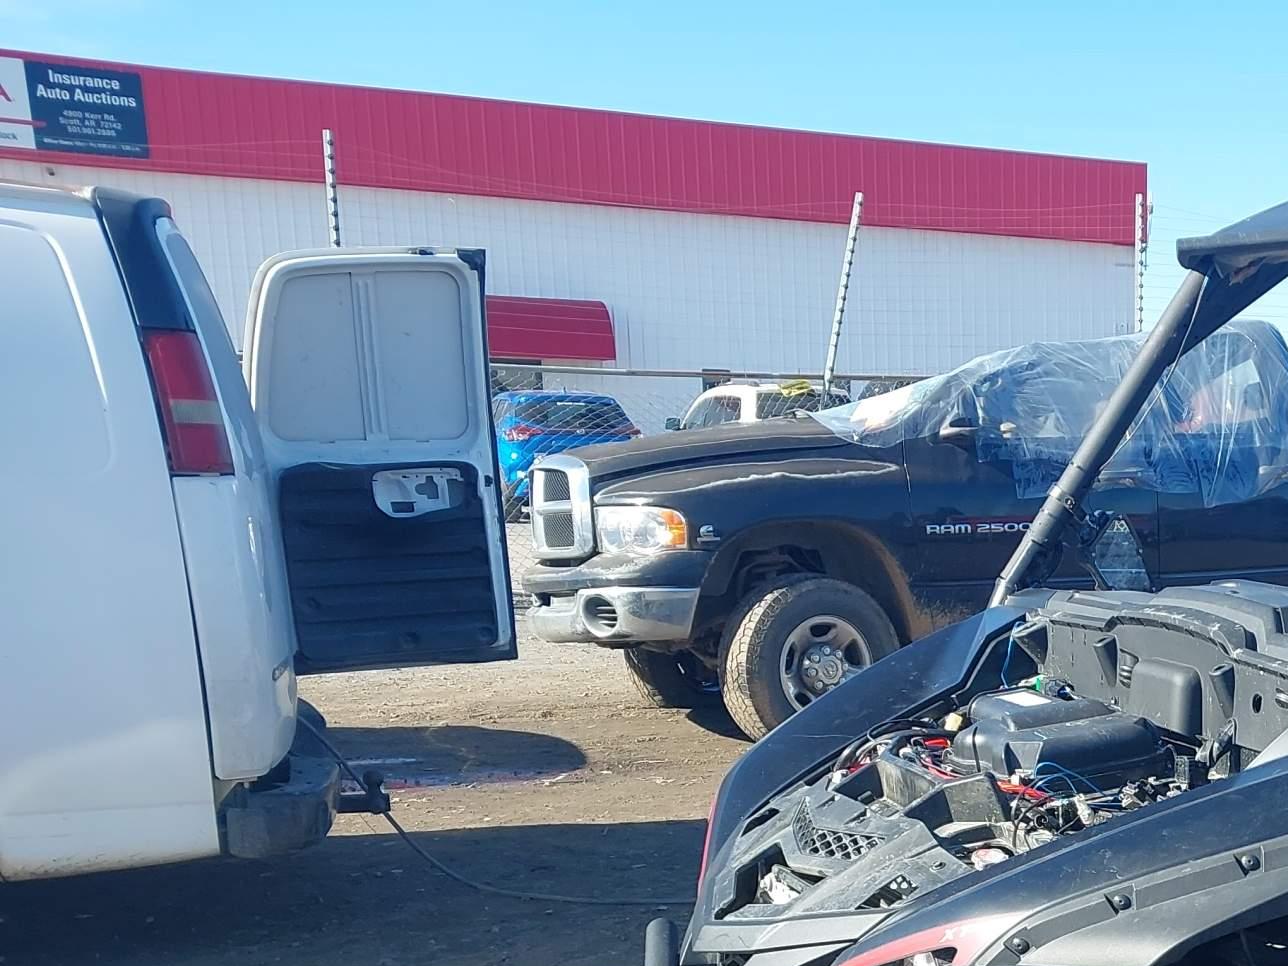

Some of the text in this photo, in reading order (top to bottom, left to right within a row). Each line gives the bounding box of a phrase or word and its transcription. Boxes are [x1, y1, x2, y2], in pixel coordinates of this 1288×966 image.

[48, 69, 120, 90] Insurance
[36, 84, 137, 107] Auto Auctions
[926, 522, 1032, 535] RAM 2500
